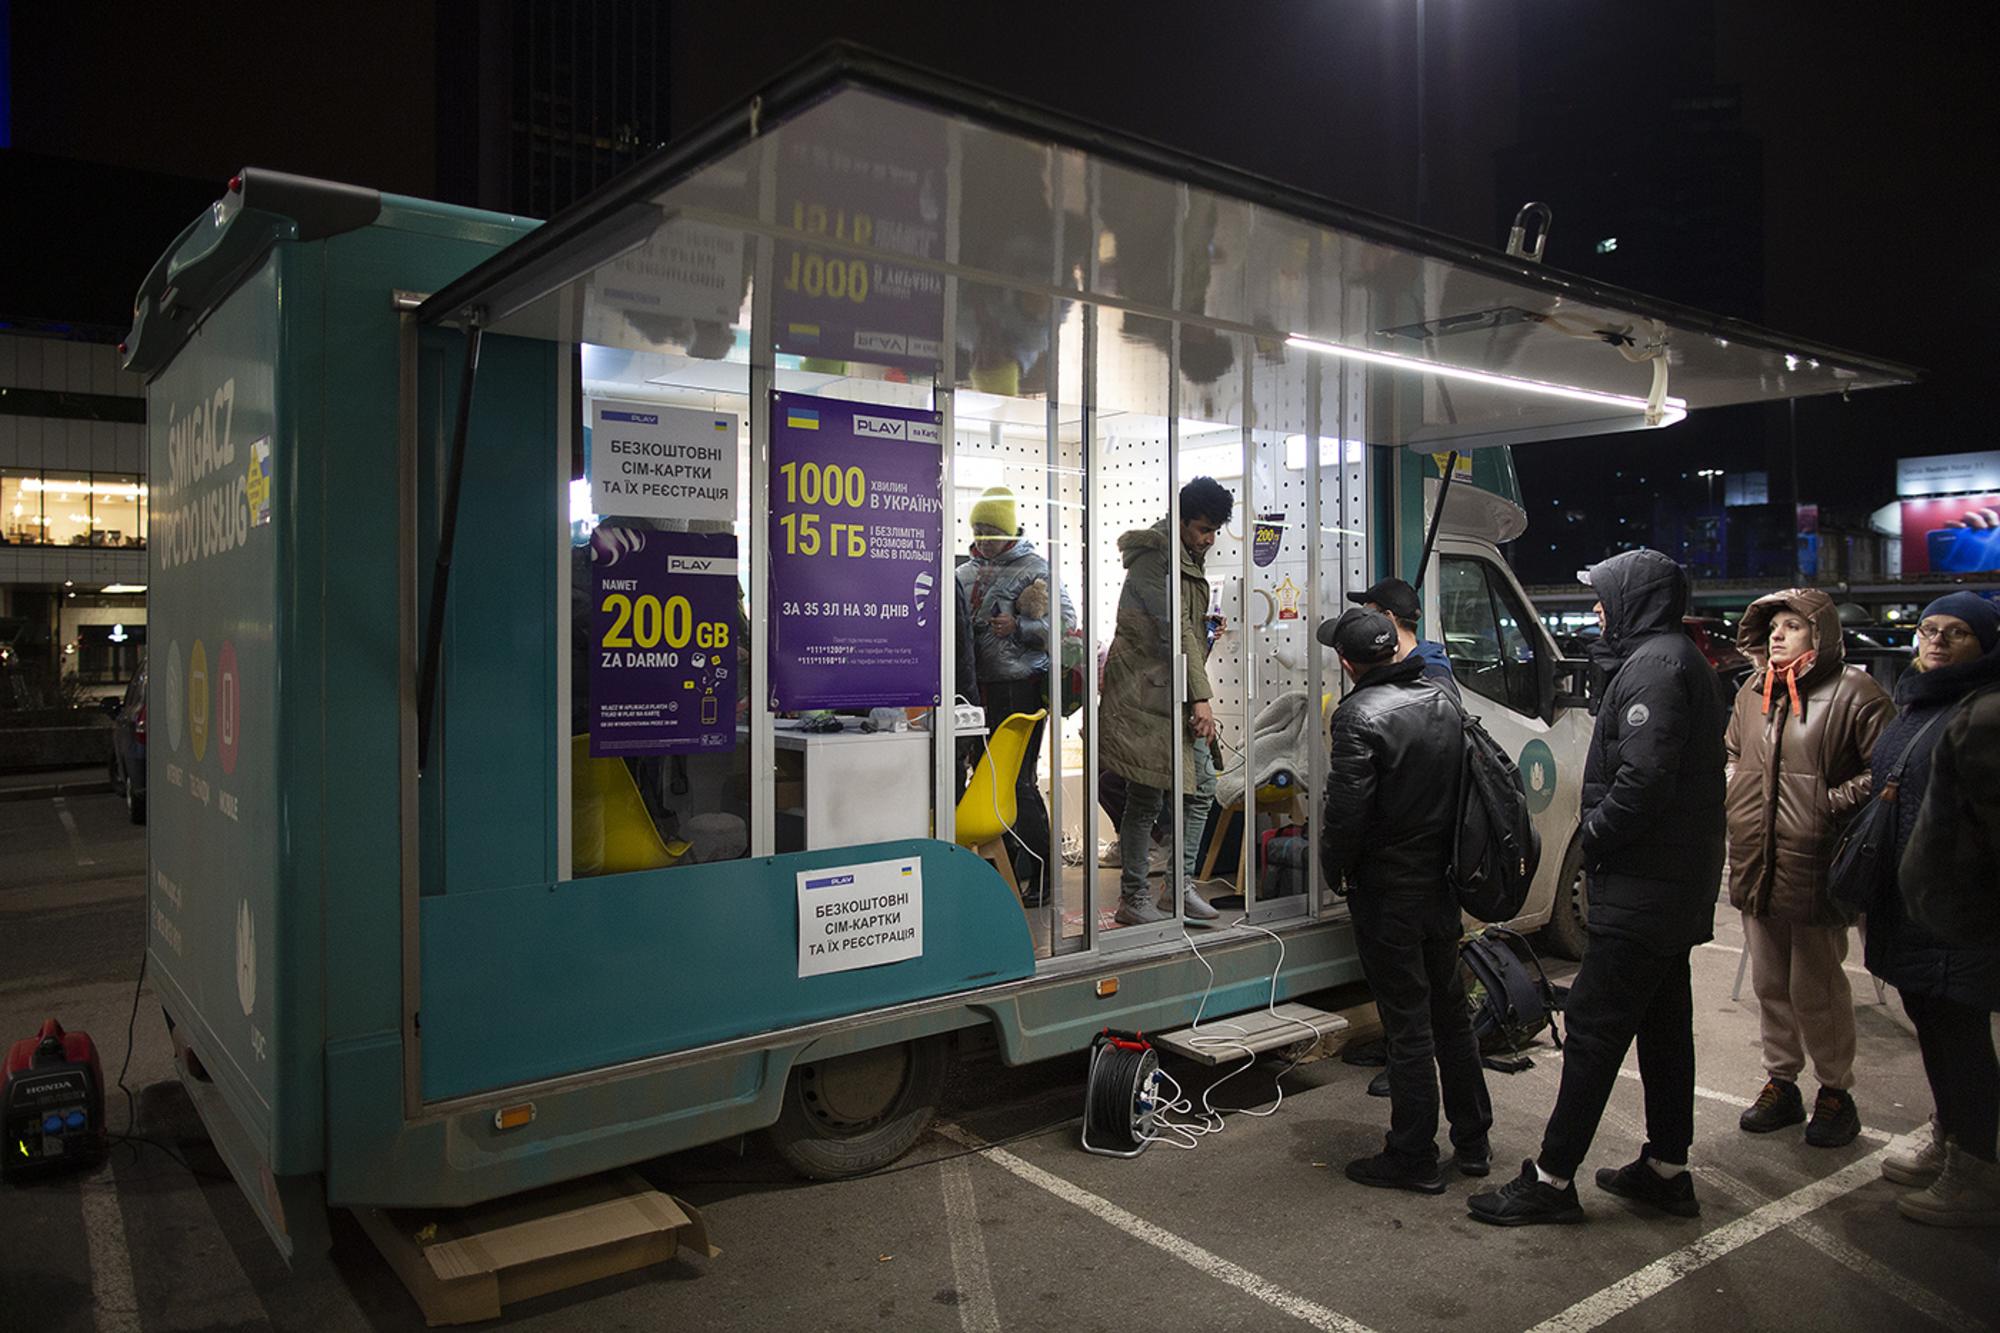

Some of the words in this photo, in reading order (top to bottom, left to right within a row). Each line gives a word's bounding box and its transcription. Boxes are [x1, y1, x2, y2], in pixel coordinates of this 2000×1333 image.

[631, 415, 656, 423] PLAY
[858, 420, 902, 434] PLAY
[169, 378, 235, 496] ŚMIGACZ
[611, 440, 722, 461] БЕЗКОШТОВНІ
[621, 461, 712, 479] СІМ-КАРТКИ
[603, 480, 621, 493] ТА
[625, 480, 638, 495] ЇХ
[643, 483, 728, 501] РЕЄСТРАЦІЯ
[780, 461, 866, 508] 1000
[871, 480, 908, 493] ХВИЛИН
[870, 494, 880, 508] В
[883, 494, 939, 513] УКРАЇНУ
[182, 500, 200, 563] DO
[202, 475, 247, 558] USŁUG
[780, 513, 821, 555] 15
[830, 523, 867, 558] ГБ
[875, 526, 925, 539] БЕЗЛІМІТНІ
[915, 539, 926, 550] ТА
[870, 548, 890, 560] SMS
[899, 550, 934, 563] ПОЛЬЩІ
[671, 560, 712, 570] PLAY
[602, 579, 638, 591] NAWET
[783, 602, 800, 616] ЗА
[804, 602, 819, 616] 35
[822, 602, 840, 616] ЗЛ
[843, 603, 860, 617] НА
[863, 603, 878, 617] 30
[880, 604, 909, 620] ДНІВ
[601, 593, 693, 649] 200
[696, 622, 729, 649] GB
[601, 652, 623, 668] ZA
[626, 652, 679, 668] DARMO
[831, 877, 852, 885] PLAY
[816, 892, 909, 918] БЕЗКОШТОВНІ
[825, 912, 901, 935] СІМ-КАРТКИ
[809, 943, 825, 956] ТА
[827, 939, 839, 953] ЇХ
[842, 927, 915, 950] РЕЄСТРАЦІЯ
[25, 1081, 73, 1095] HONDA
